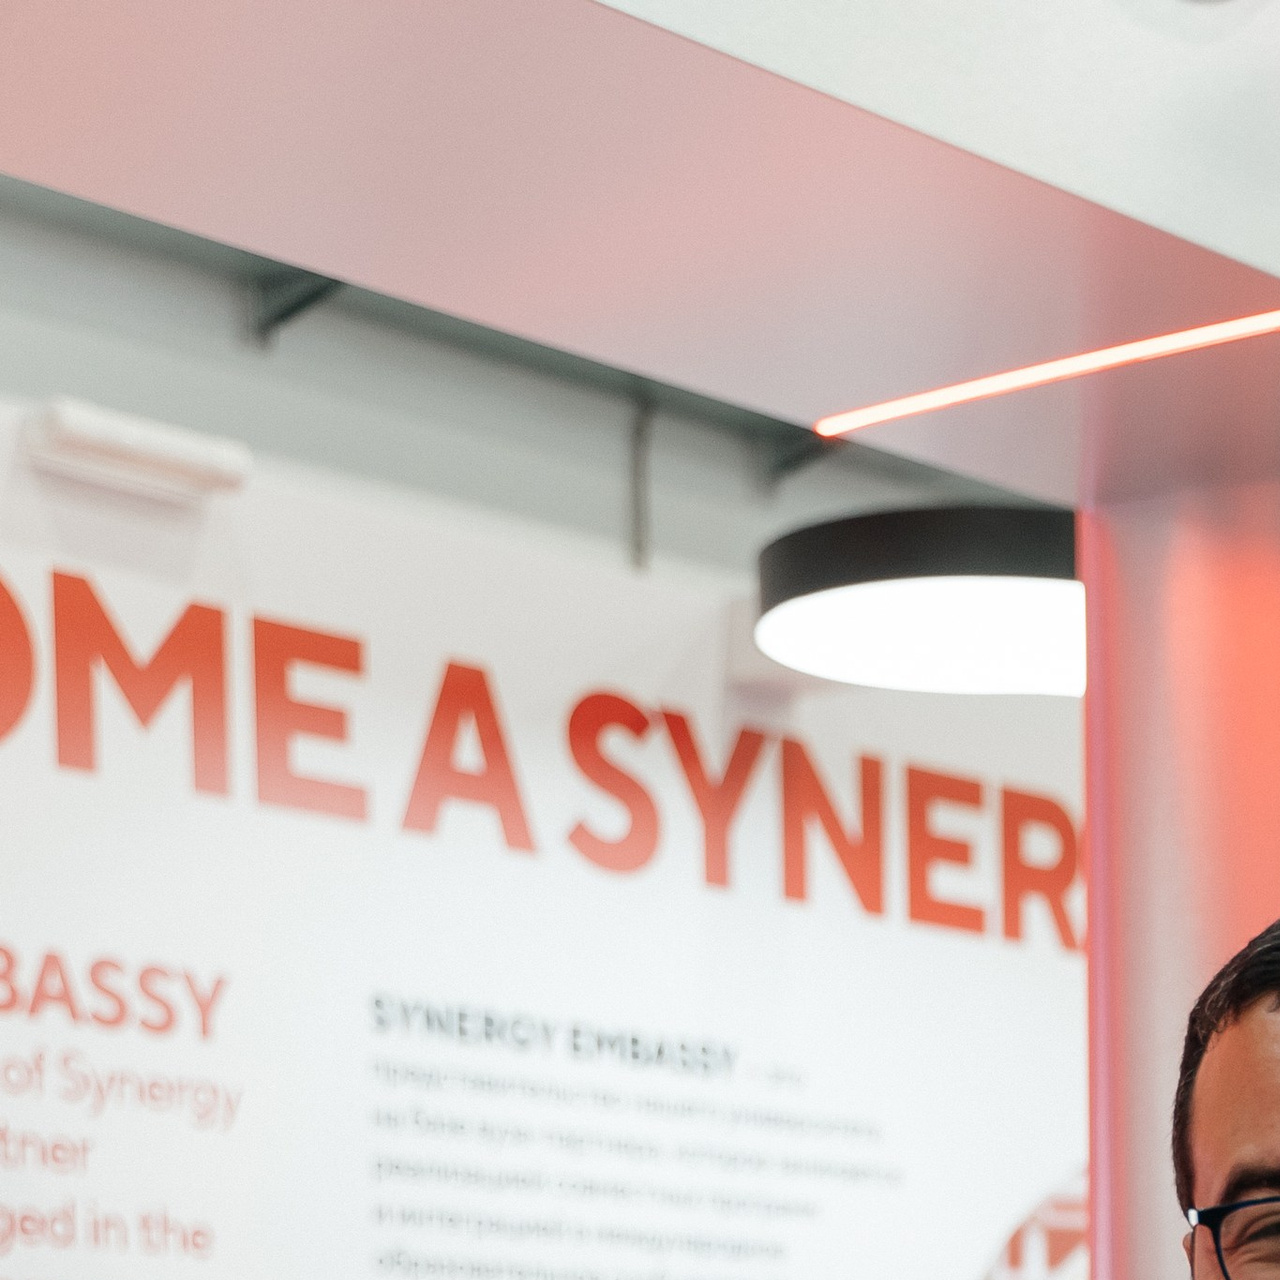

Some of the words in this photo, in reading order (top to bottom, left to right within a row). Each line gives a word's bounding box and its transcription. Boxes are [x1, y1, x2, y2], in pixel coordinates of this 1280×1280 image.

[0, 564, 369, 824] ME
[402, 657, 538, 856] A
[564, 687, 1087, 957] SYNER
[57, 1048, 244, 1132] Synergy
[87, 1201, 130, 1250] in
[138, 1206, 215, 1260] the
